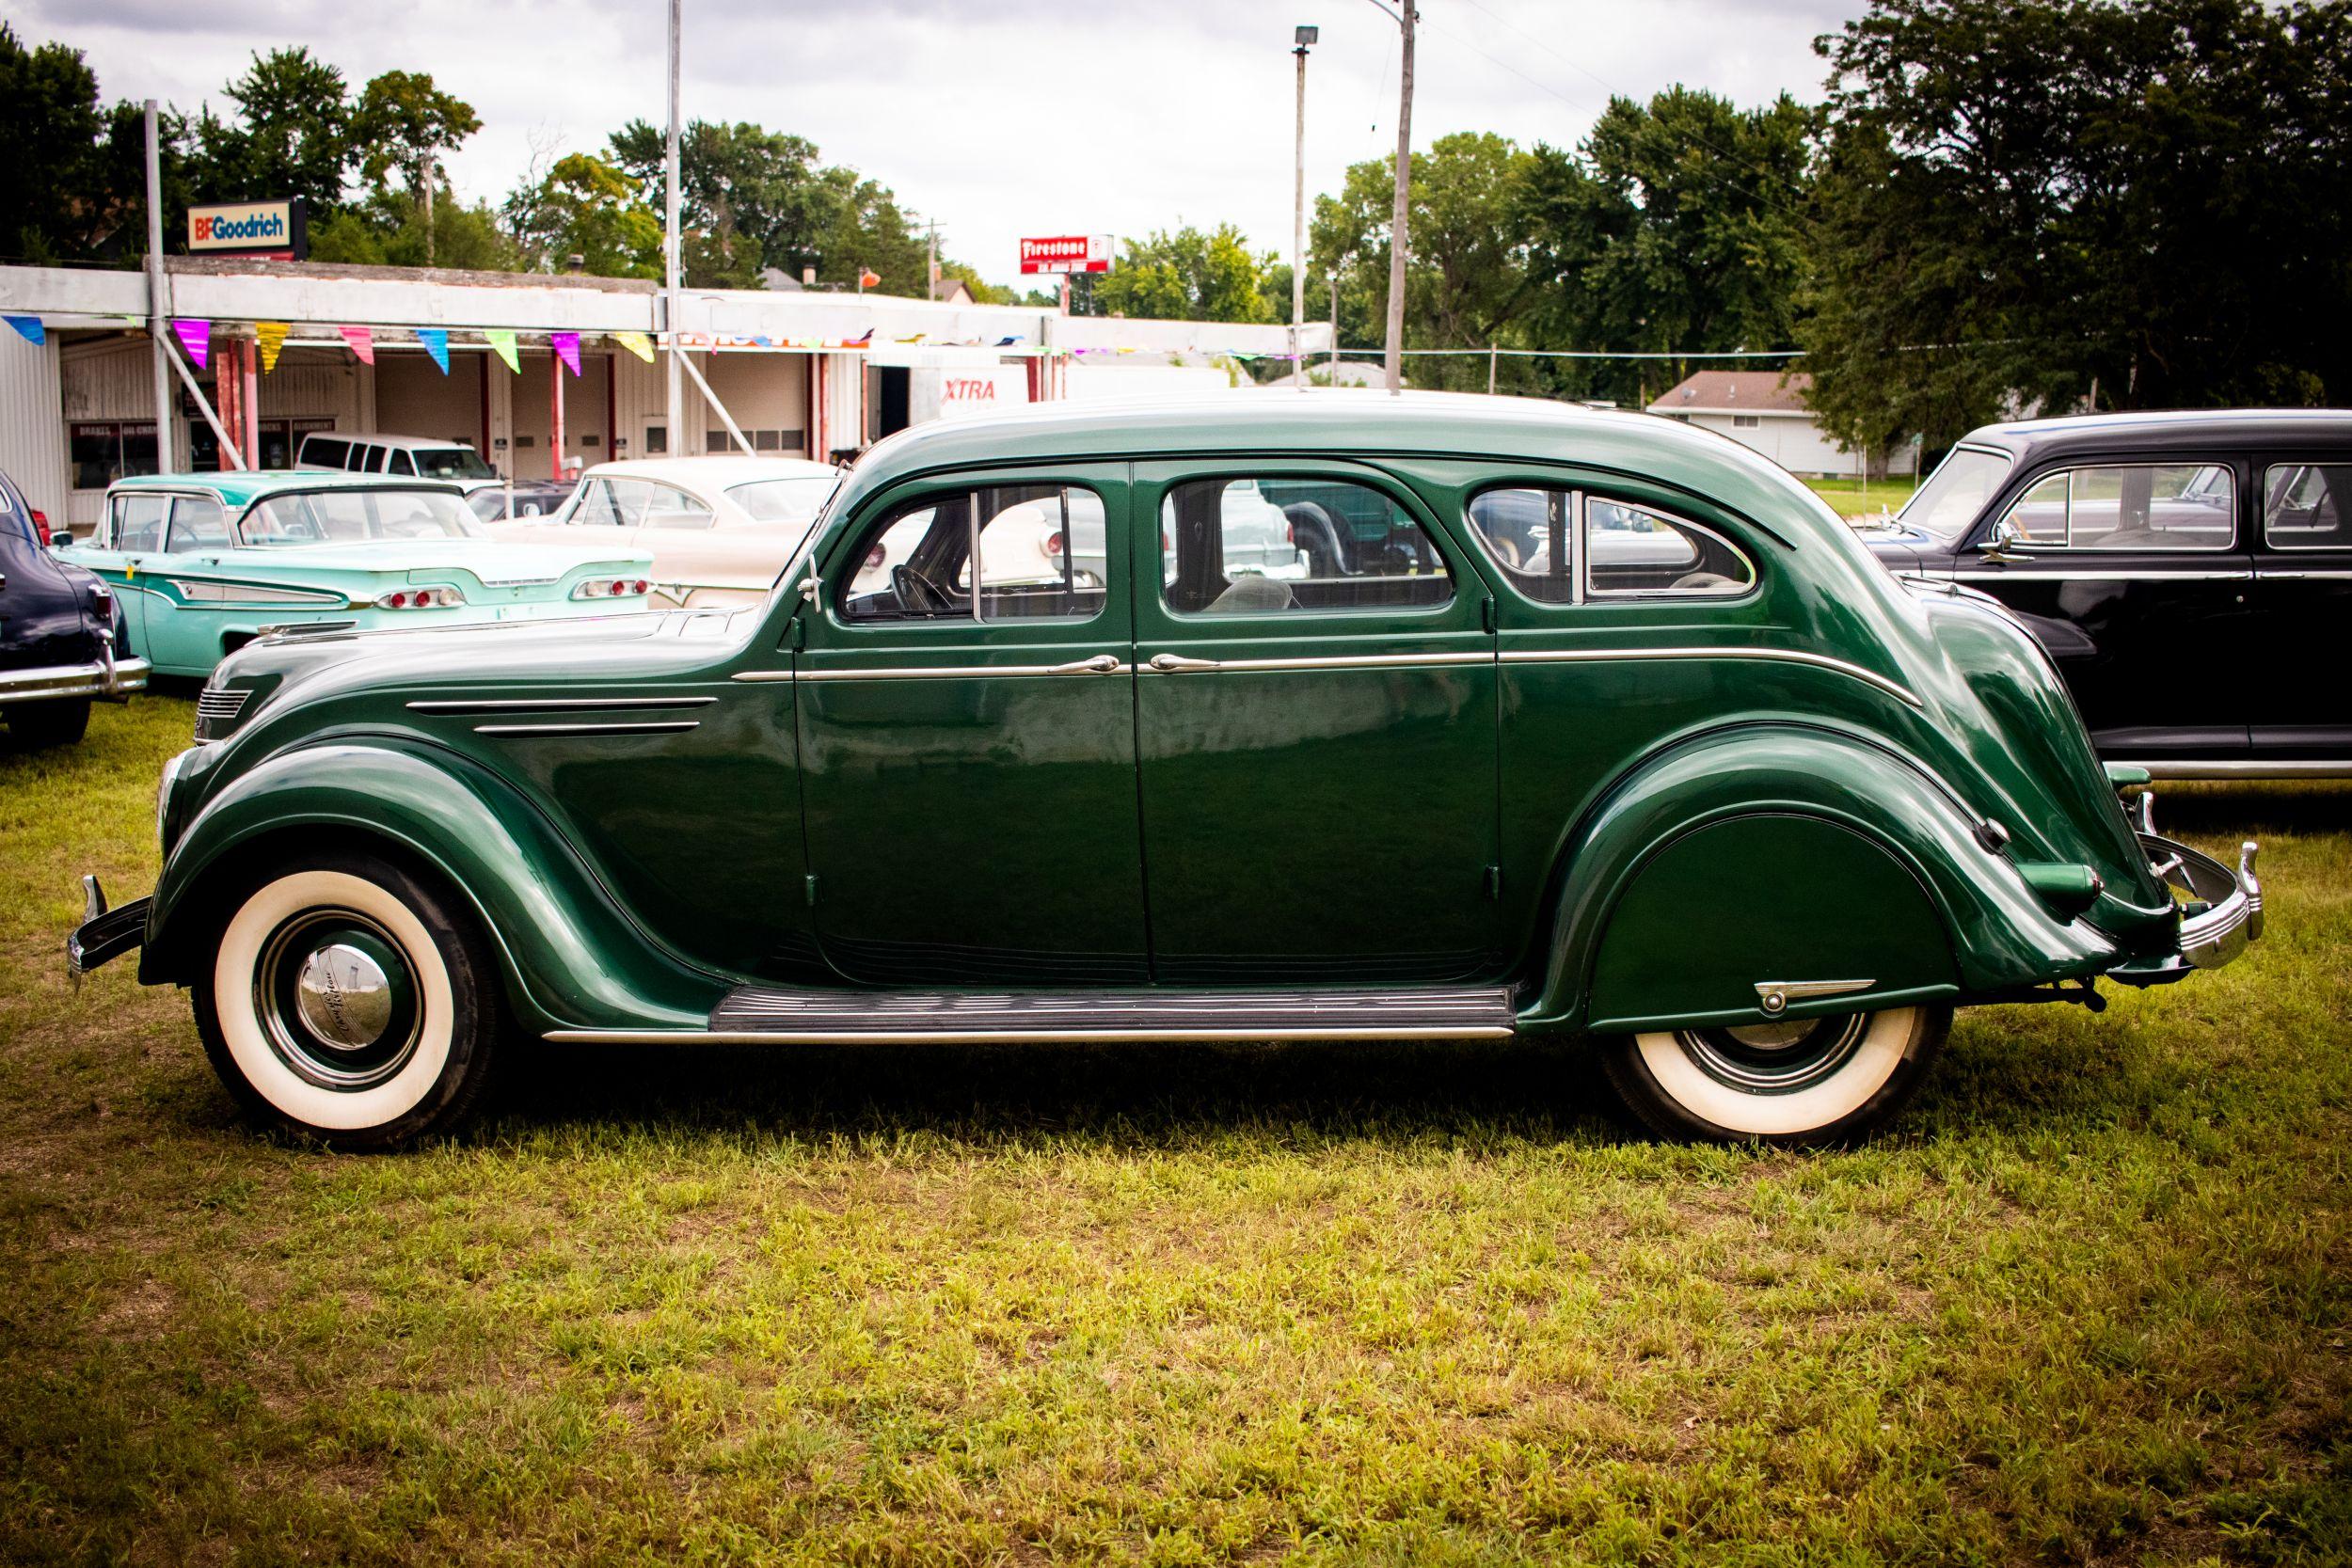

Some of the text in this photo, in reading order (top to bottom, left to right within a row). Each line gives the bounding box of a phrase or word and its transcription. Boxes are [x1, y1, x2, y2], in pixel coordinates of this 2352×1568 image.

[195, 212, 283, 241] BFGoodrich
[1023, 241, 1086, 260] Firestone
[941, 378, 995, 405] XTRA
